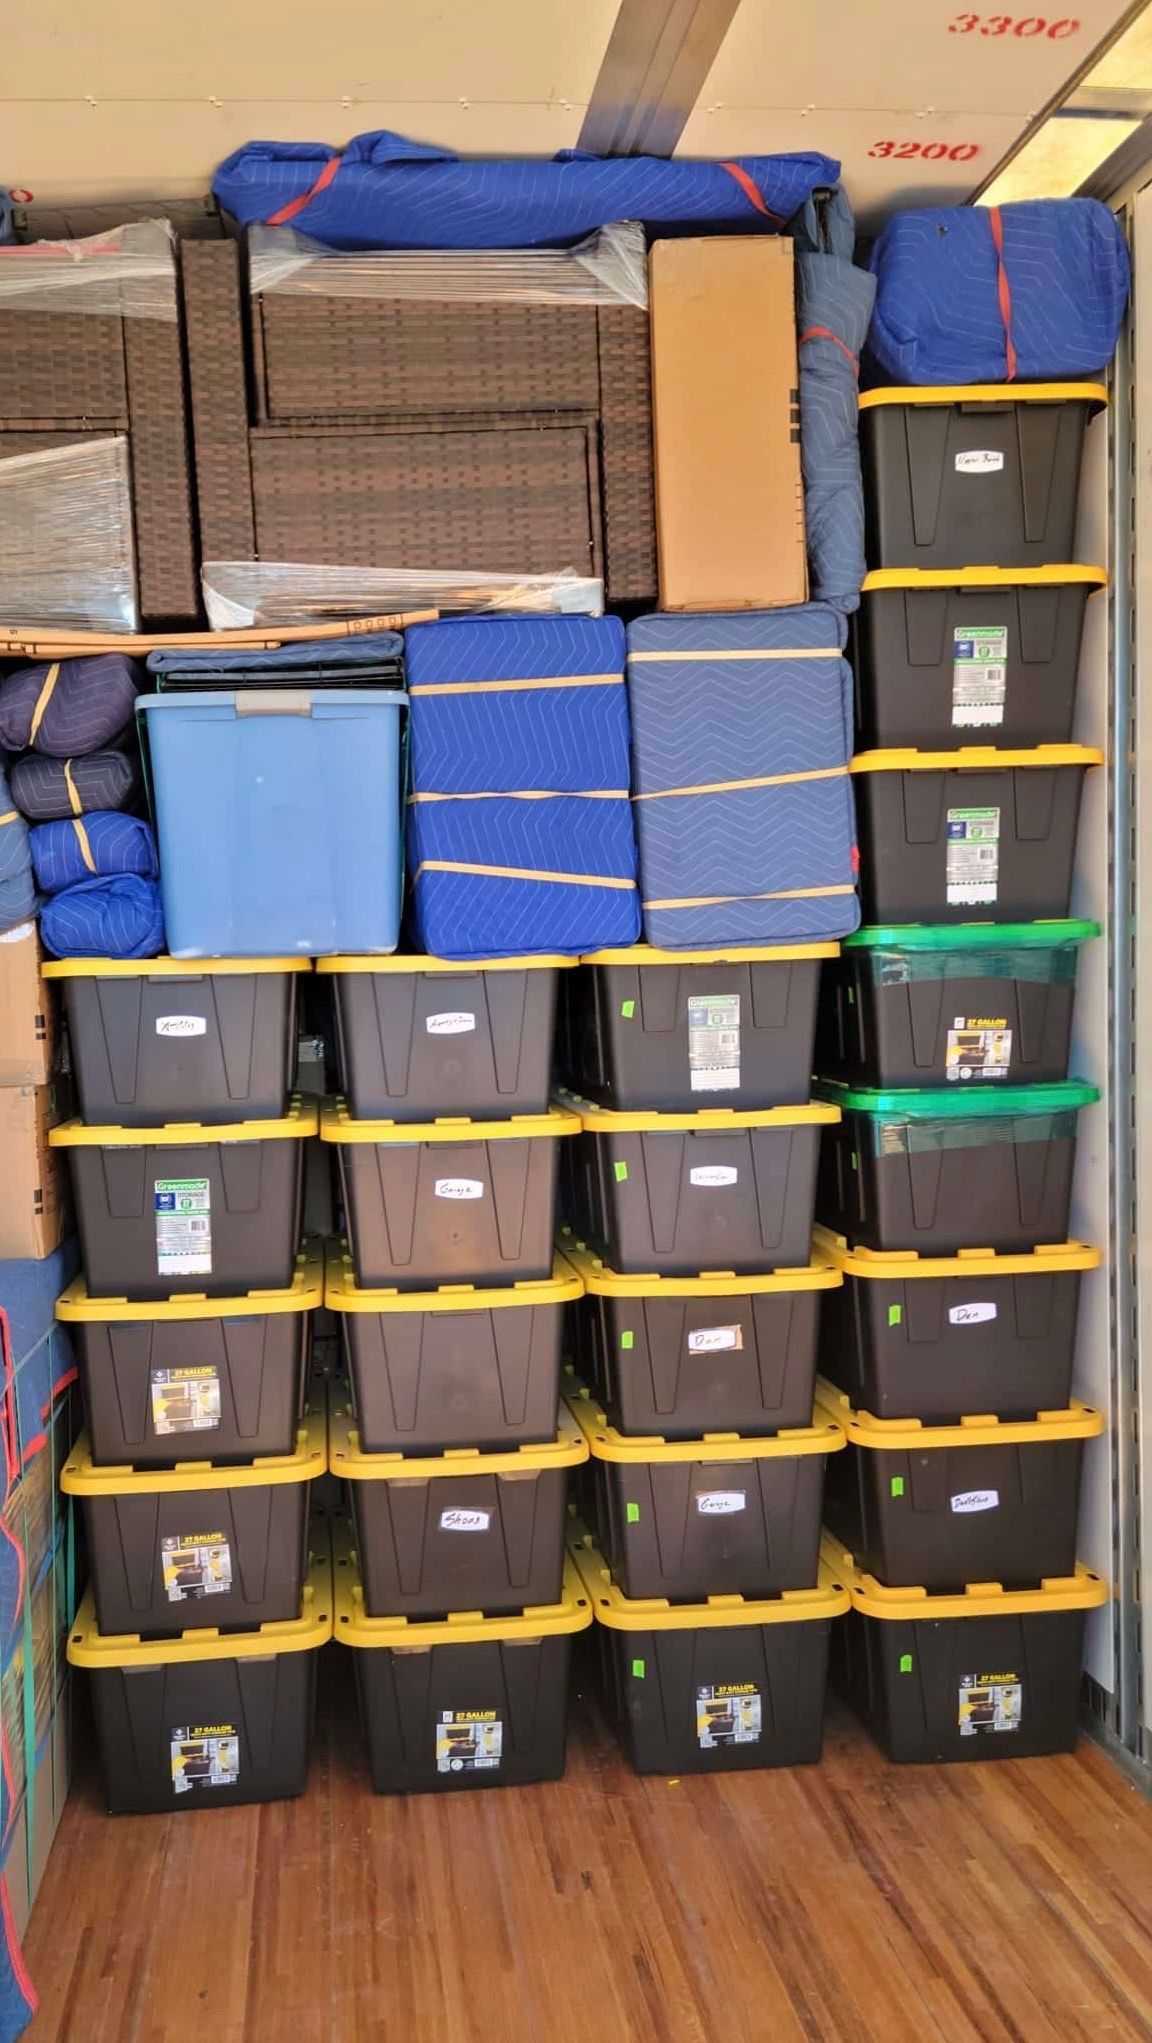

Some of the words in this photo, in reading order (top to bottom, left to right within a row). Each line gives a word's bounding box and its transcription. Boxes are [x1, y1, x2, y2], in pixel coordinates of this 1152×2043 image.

[948, 14, 1081, 39] 3300
[867, 141, 982, 161] 3200
[977, 1018, 1008, 1026] GALLON
[956, 1308, 979, 1322] Den
[184, 1367, 213, 1376] GALLON
[445, 1512, 481, 1526] Shoes
[193, 1532, 222, 1542] GALLON
[989, 1673, 1017, 1681] GALLON
[727, 1684, 755, 1692] GALLON
[466, 1710, 496, 1719] GALLON
[203, 1724, 232, 1733] GALLON
